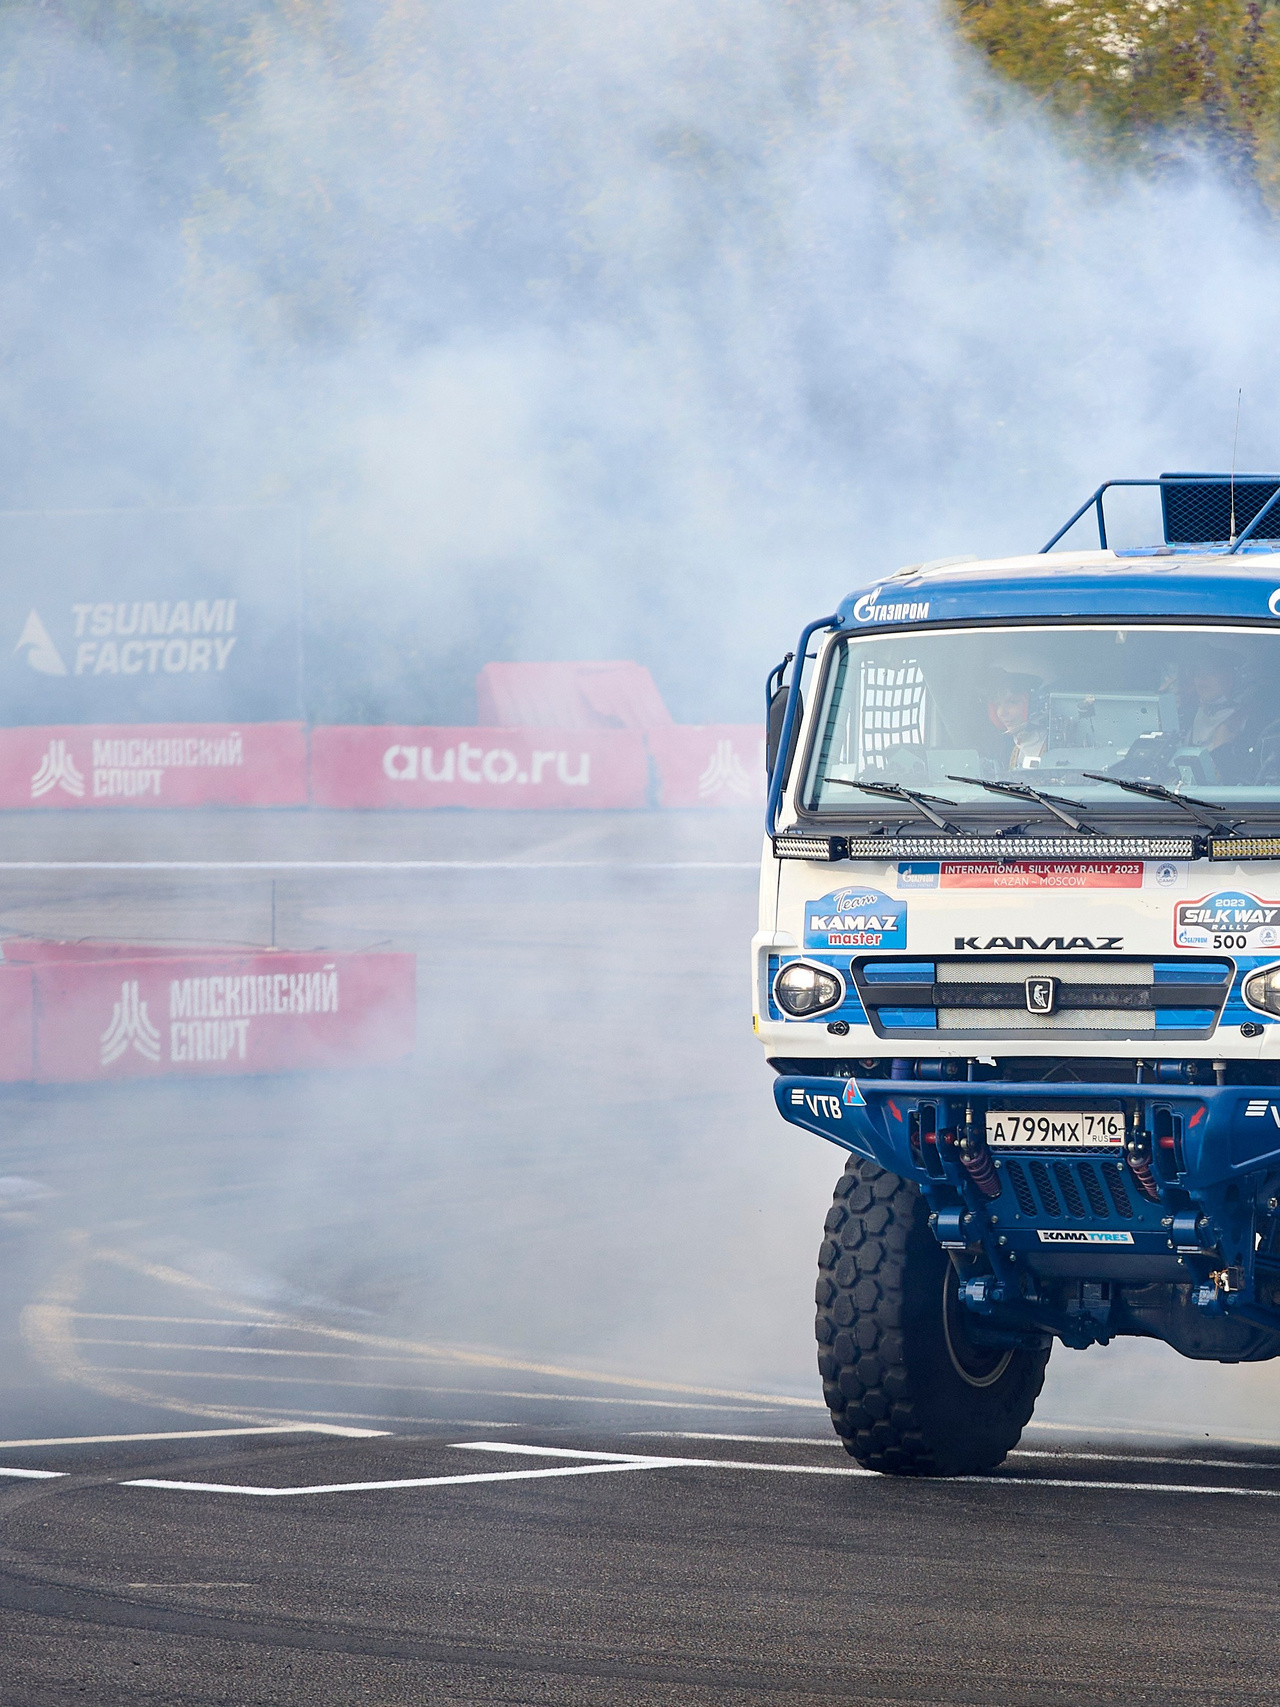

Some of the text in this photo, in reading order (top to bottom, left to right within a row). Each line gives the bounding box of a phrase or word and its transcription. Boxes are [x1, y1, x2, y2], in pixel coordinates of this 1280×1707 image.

[71, 599, 238, 637] TSUNAMI
[74, 638, 238, 676] FACTORY
[92, 730, 244, 770] МОСКОВСКИЙ
[381, 741, 591, 787] auto.ru
[92, 767, 164, 798] СПОРТ
[944, 864, 1140, 875] INTERNATIONAL SILK WAY RALLY 2023
[993, 876, 1028, 887] KAZAN
[1039, 877, 1087, 887] MOSCOW
[833, 888, 878, 912] Team
[1215, 898, 1246, 908] 2023
[810, 914, 899, 931] KAMAZ
[1183, 909, 1279, 923] SILK WAY
[828, 932, 883, 946] master
[953, 936, 1125, 951] KAMAZ
[1213, 934, 1248, 949] 500
[169, 962, 339, 1019] МОСКОВСКИЙ
[169, 1017, 250, 1063] СПОРТ
[805, 1094, 843, 1119] VTB
[1084, 1115, 1119, 1136] 716
[1092, 1135, 1109, 1143] RUS
